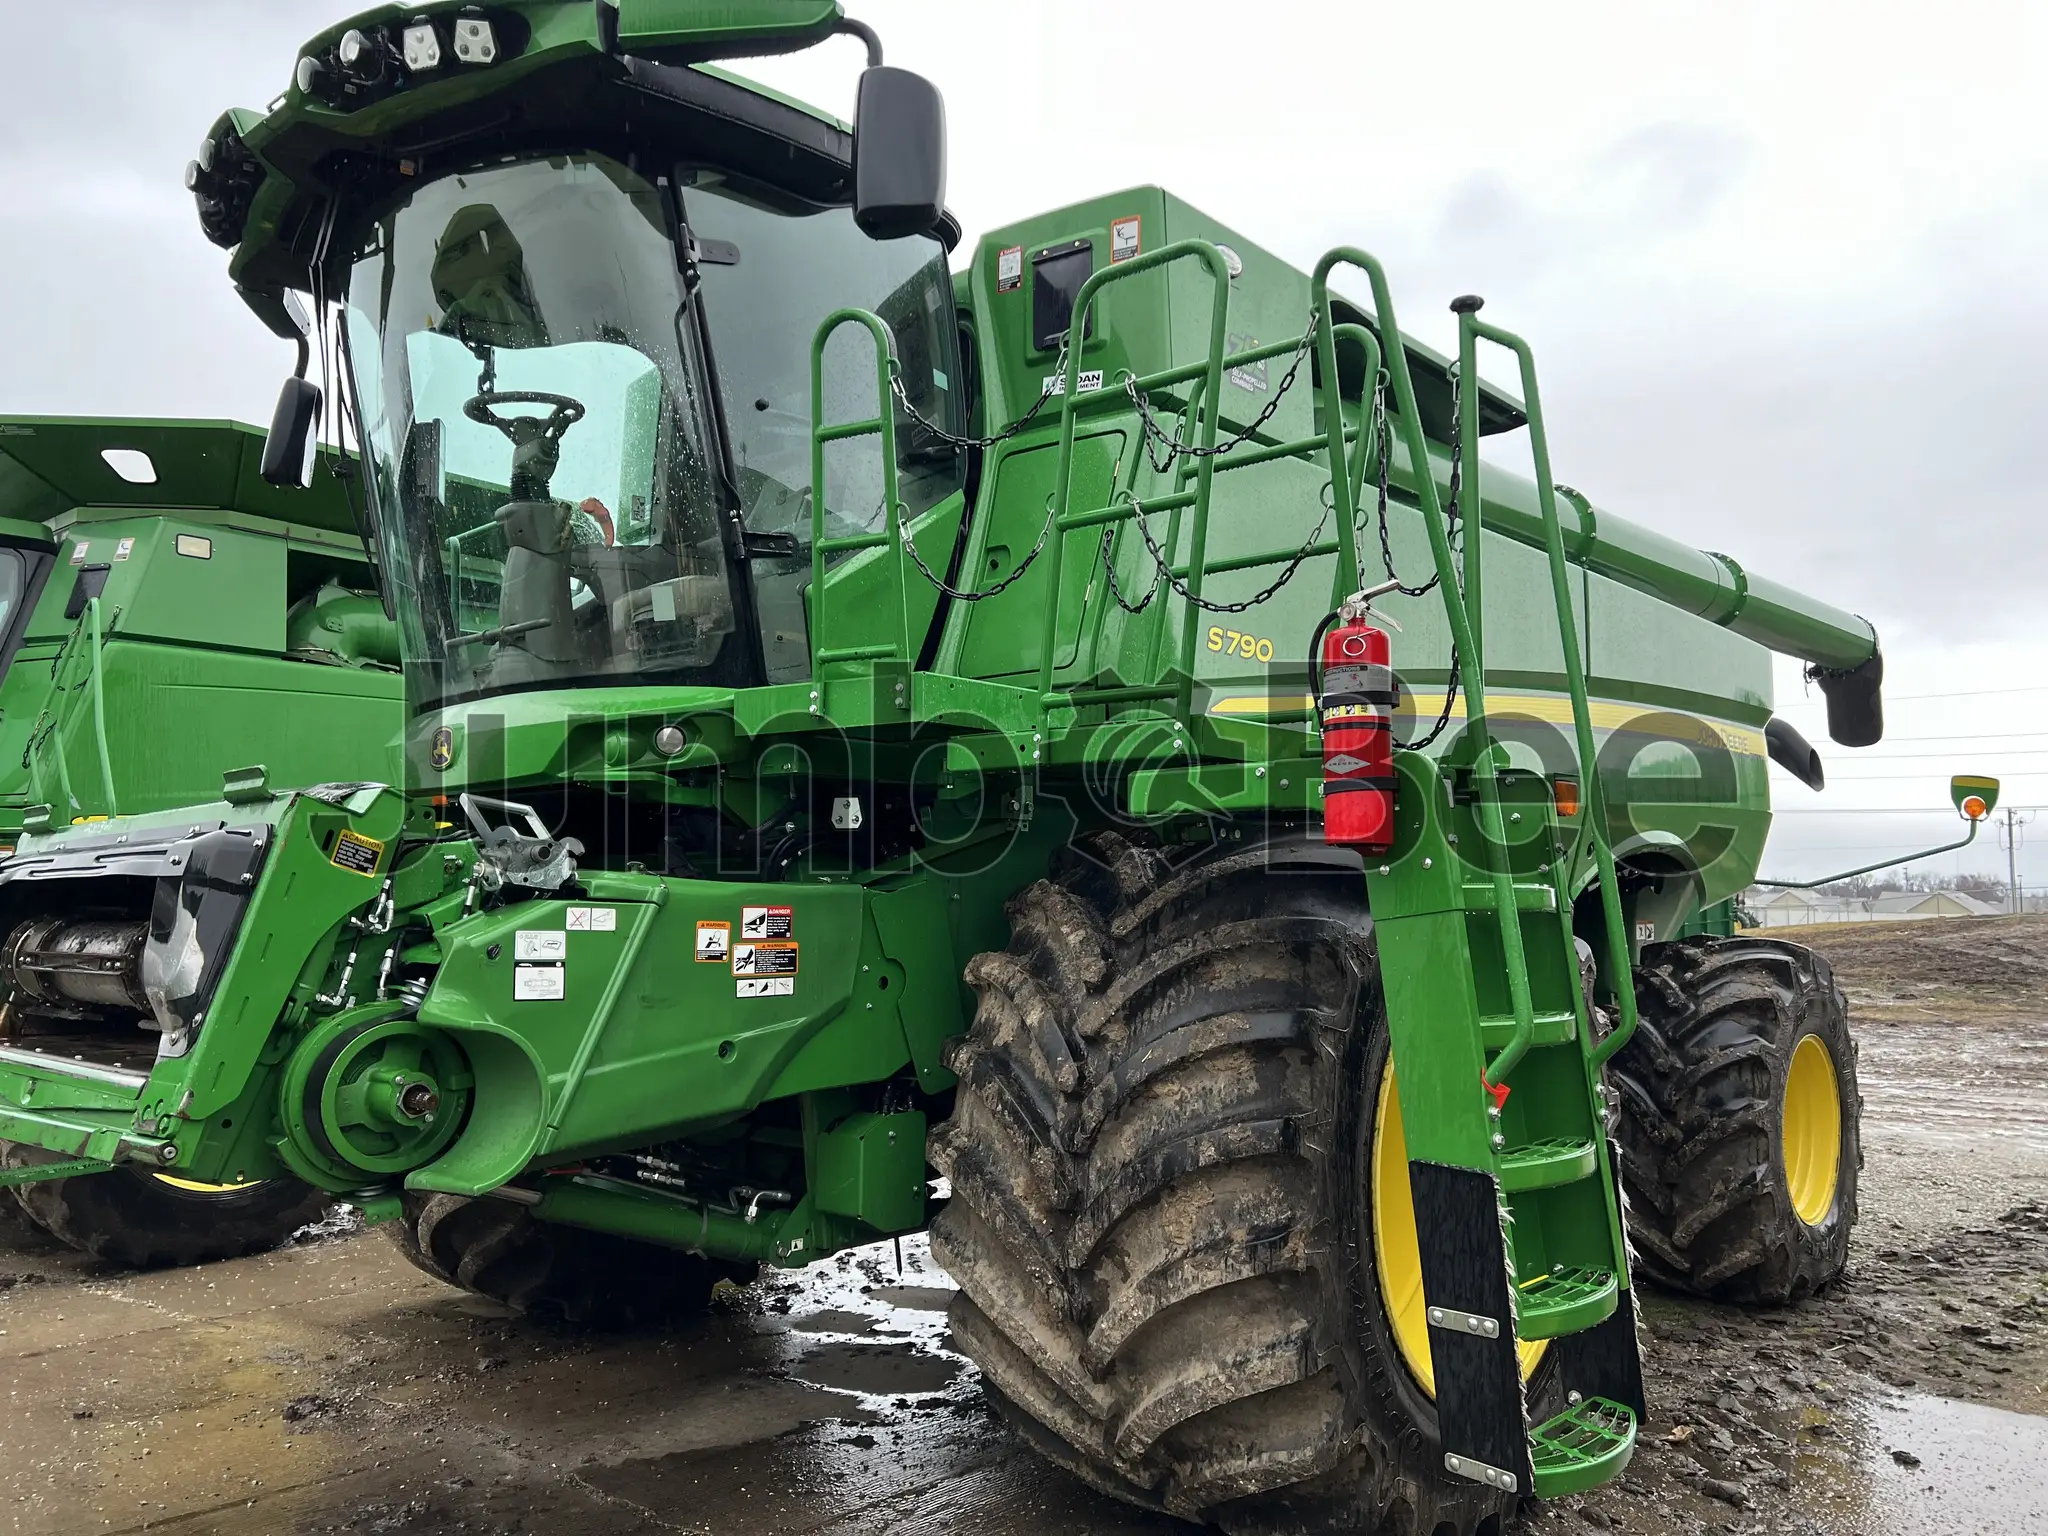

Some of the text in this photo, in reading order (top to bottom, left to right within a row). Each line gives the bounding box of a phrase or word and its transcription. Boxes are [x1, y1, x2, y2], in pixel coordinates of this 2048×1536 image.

[1059, 373, 1101, 387] SAN
[1207, 625, 1274, 663] S790
[348, 834, 382, 850] CAUTION
